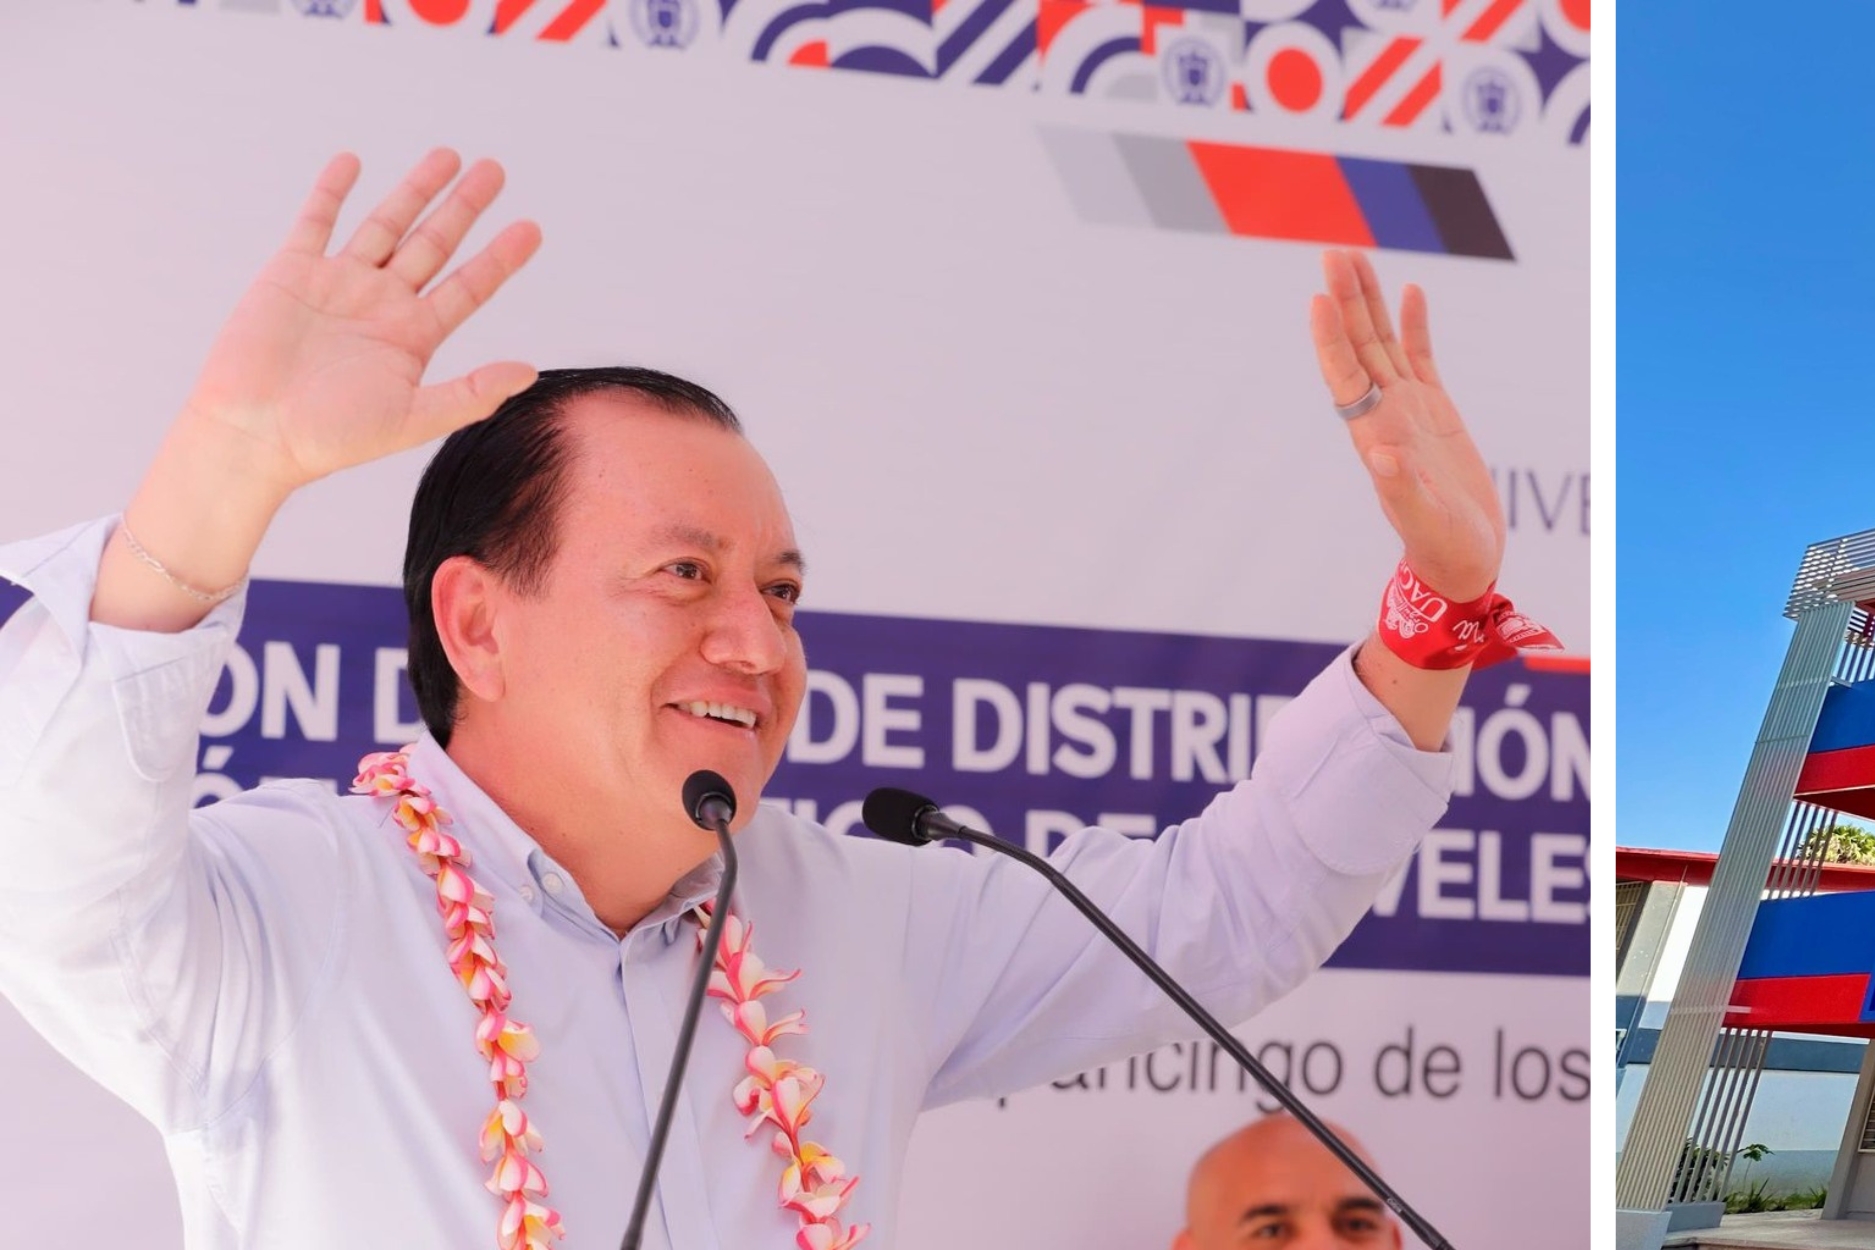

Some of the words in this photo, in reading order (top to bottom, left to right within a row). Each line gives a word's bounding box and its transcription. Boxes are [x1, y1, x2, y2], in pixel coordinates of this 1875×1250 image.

[786, 668, 924, 769] DE
[1373, 1024, 1462, 1100] de
[1494, 1028, 1590, 1102] los
